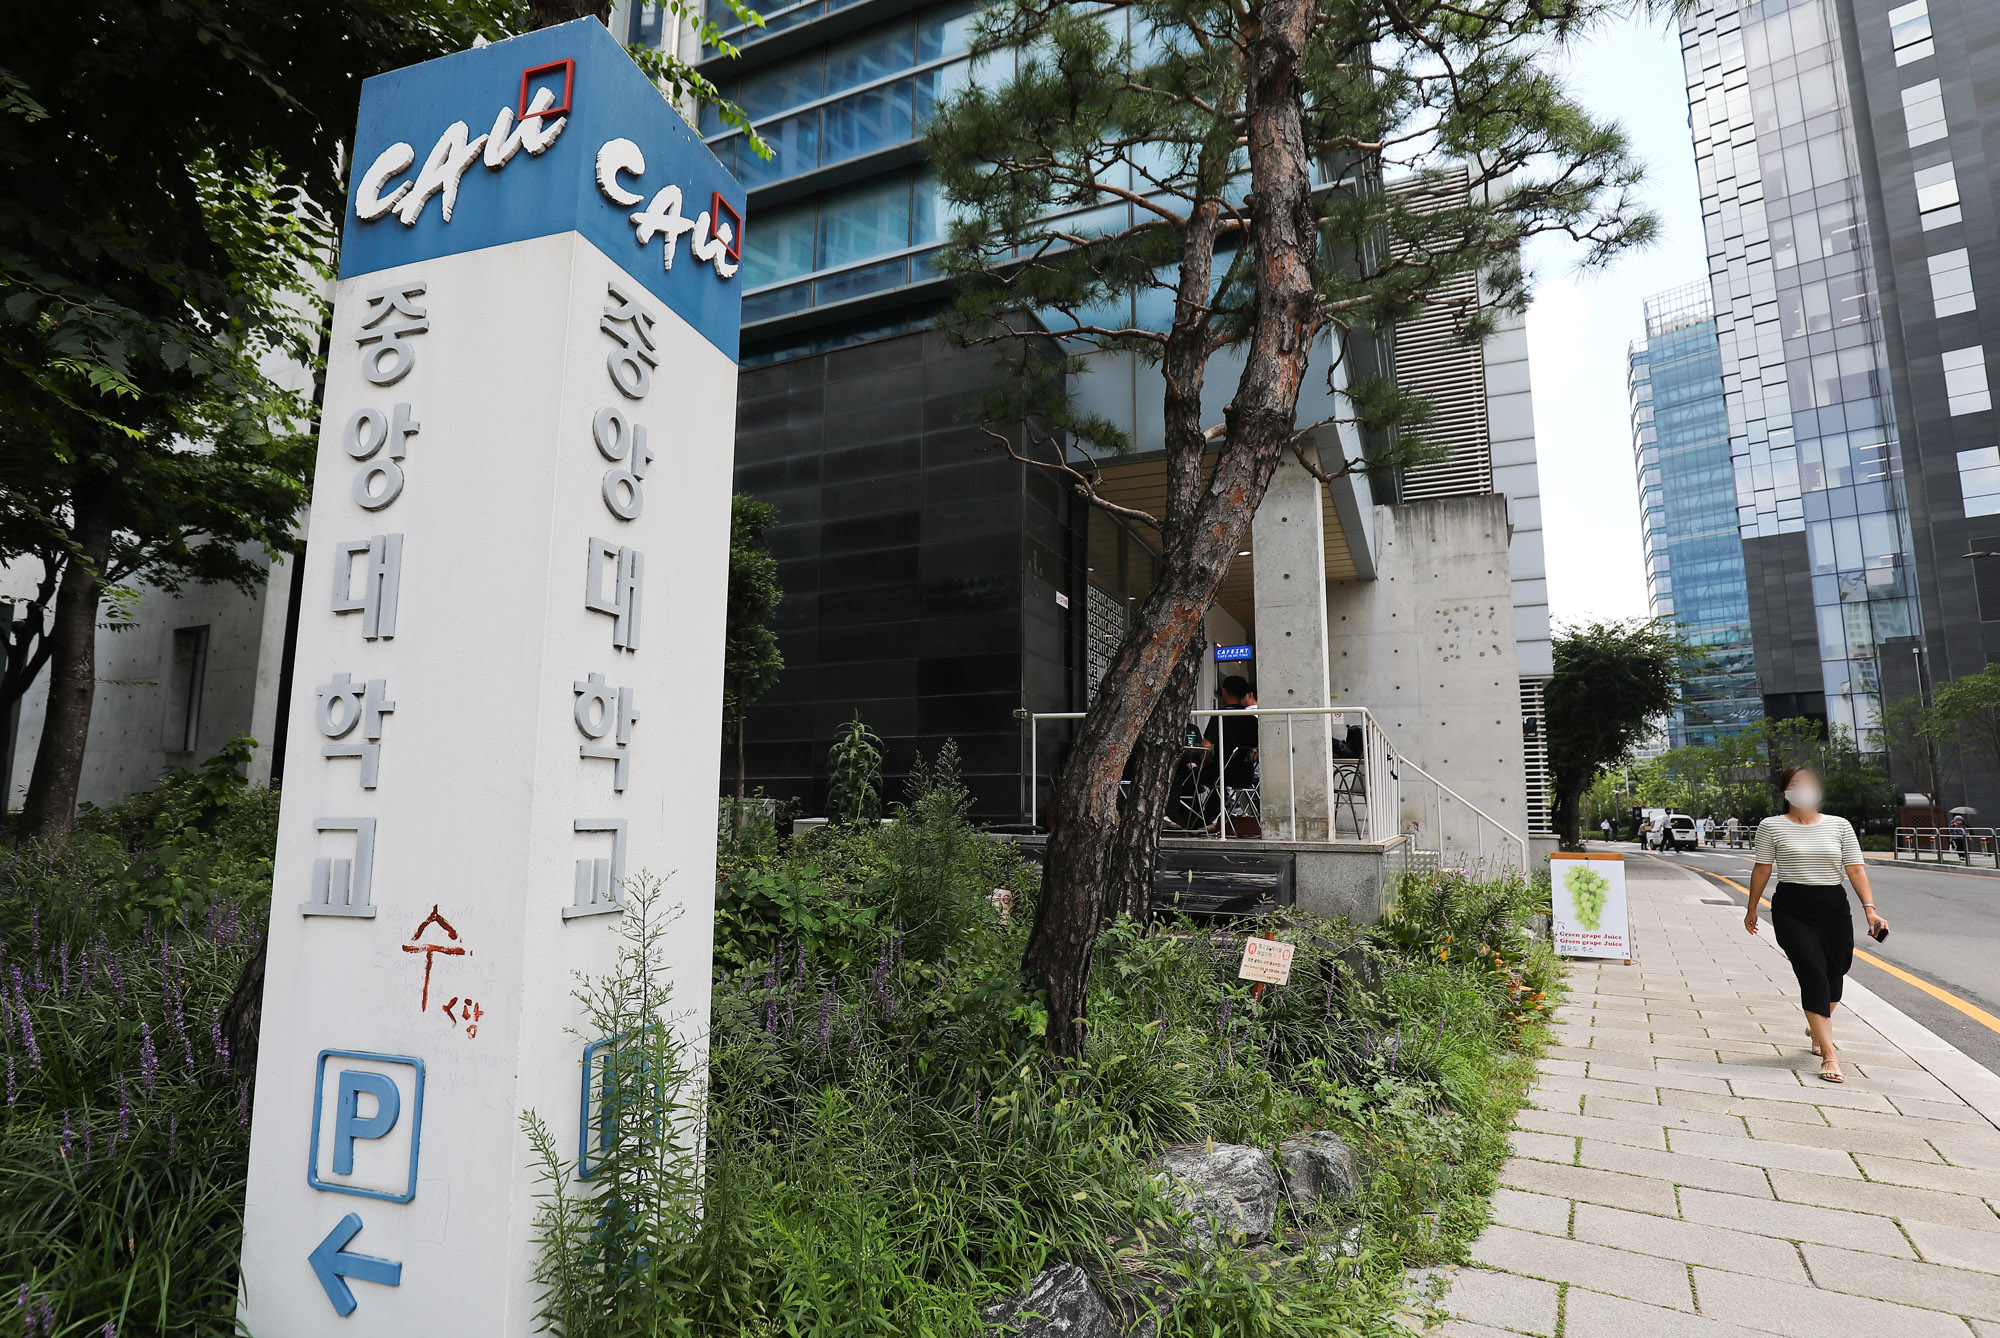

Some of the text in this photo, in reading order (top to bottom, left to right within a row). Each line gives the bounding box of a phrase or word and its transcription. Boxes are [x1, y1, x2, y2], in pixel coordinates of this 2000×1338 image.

[300, 281, 429, 919] 중앙대학교
[562, 281, 660, 921] 중앙대학교
[331, 1069, 399, 1175] P
